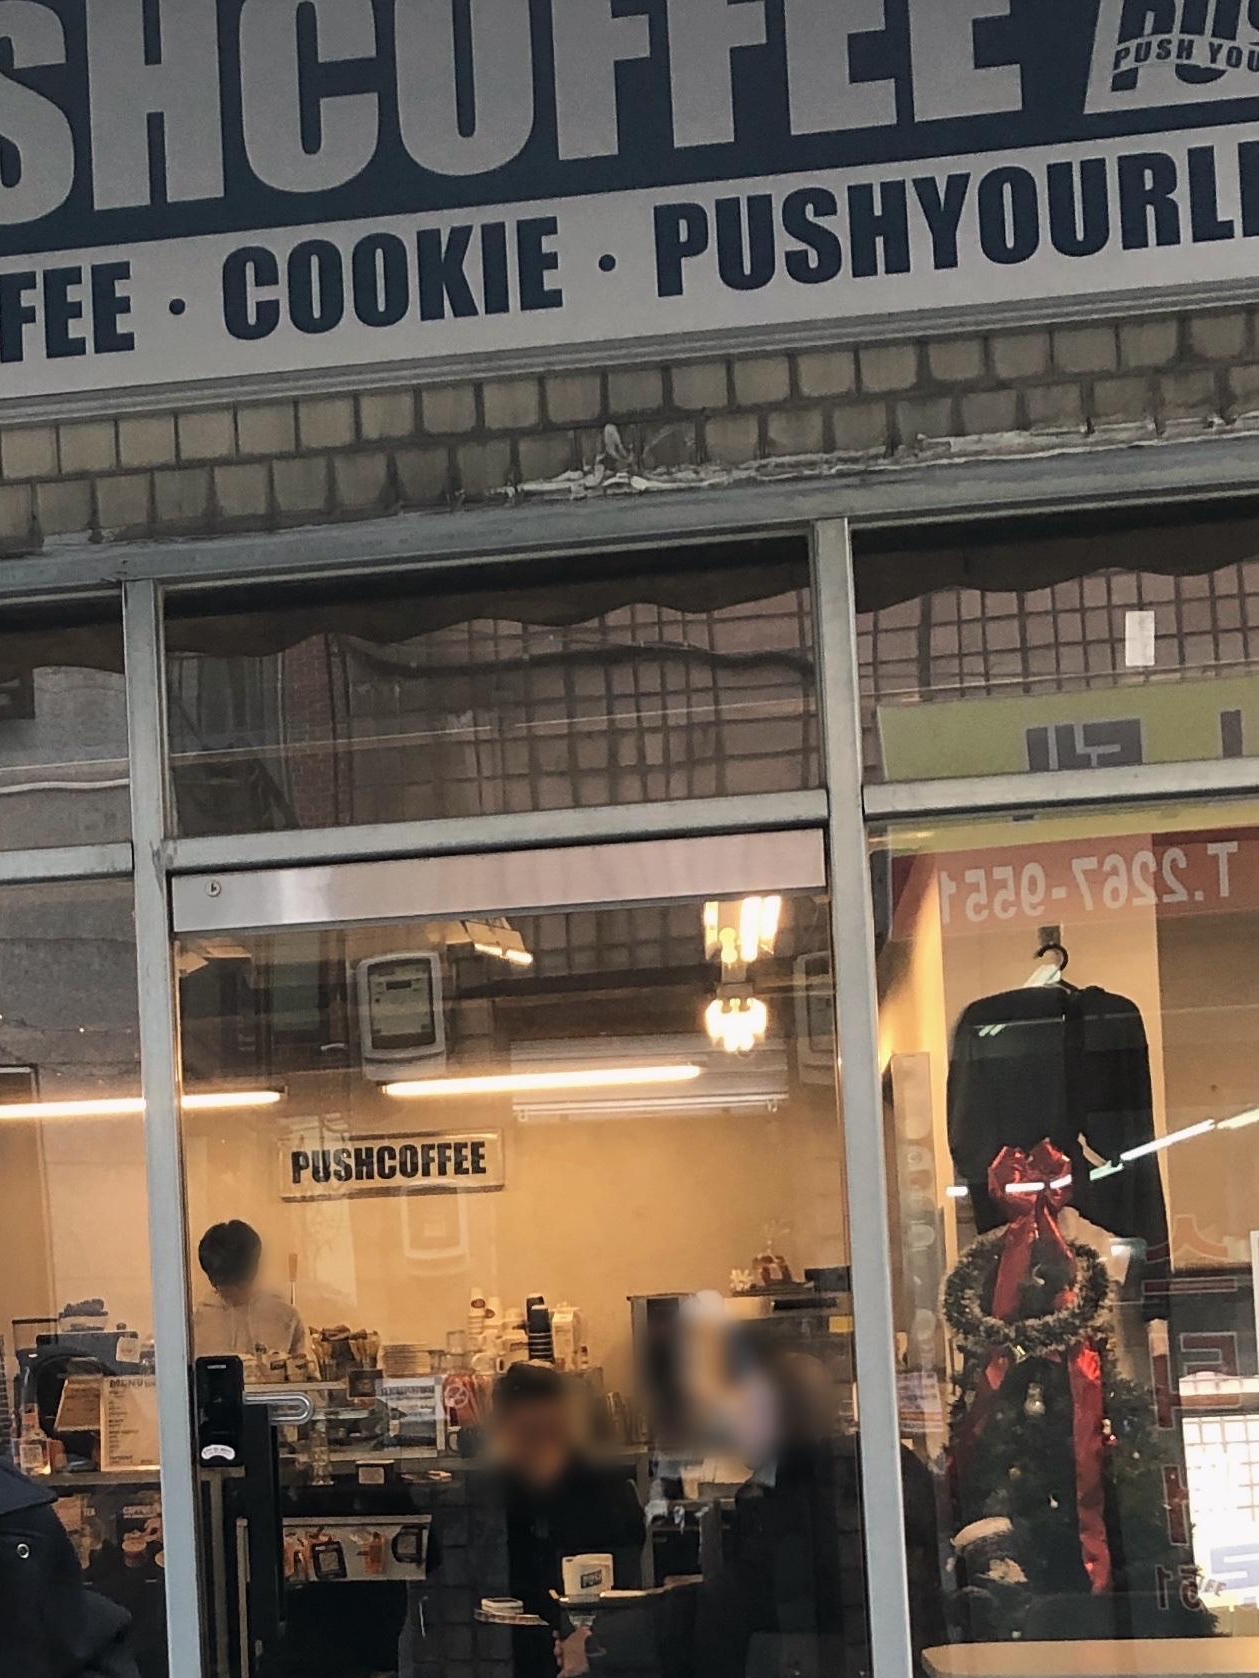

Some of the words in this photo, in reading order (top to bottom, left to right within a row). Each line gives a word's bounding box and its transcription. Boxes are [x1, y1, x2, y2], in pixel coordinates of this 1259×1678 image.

[1113, 38, 1194, 71] PUSH
[222, 215, 564, 341] COOKIE
[291, 1141, 487, 1184] PUSHCOFFEE
